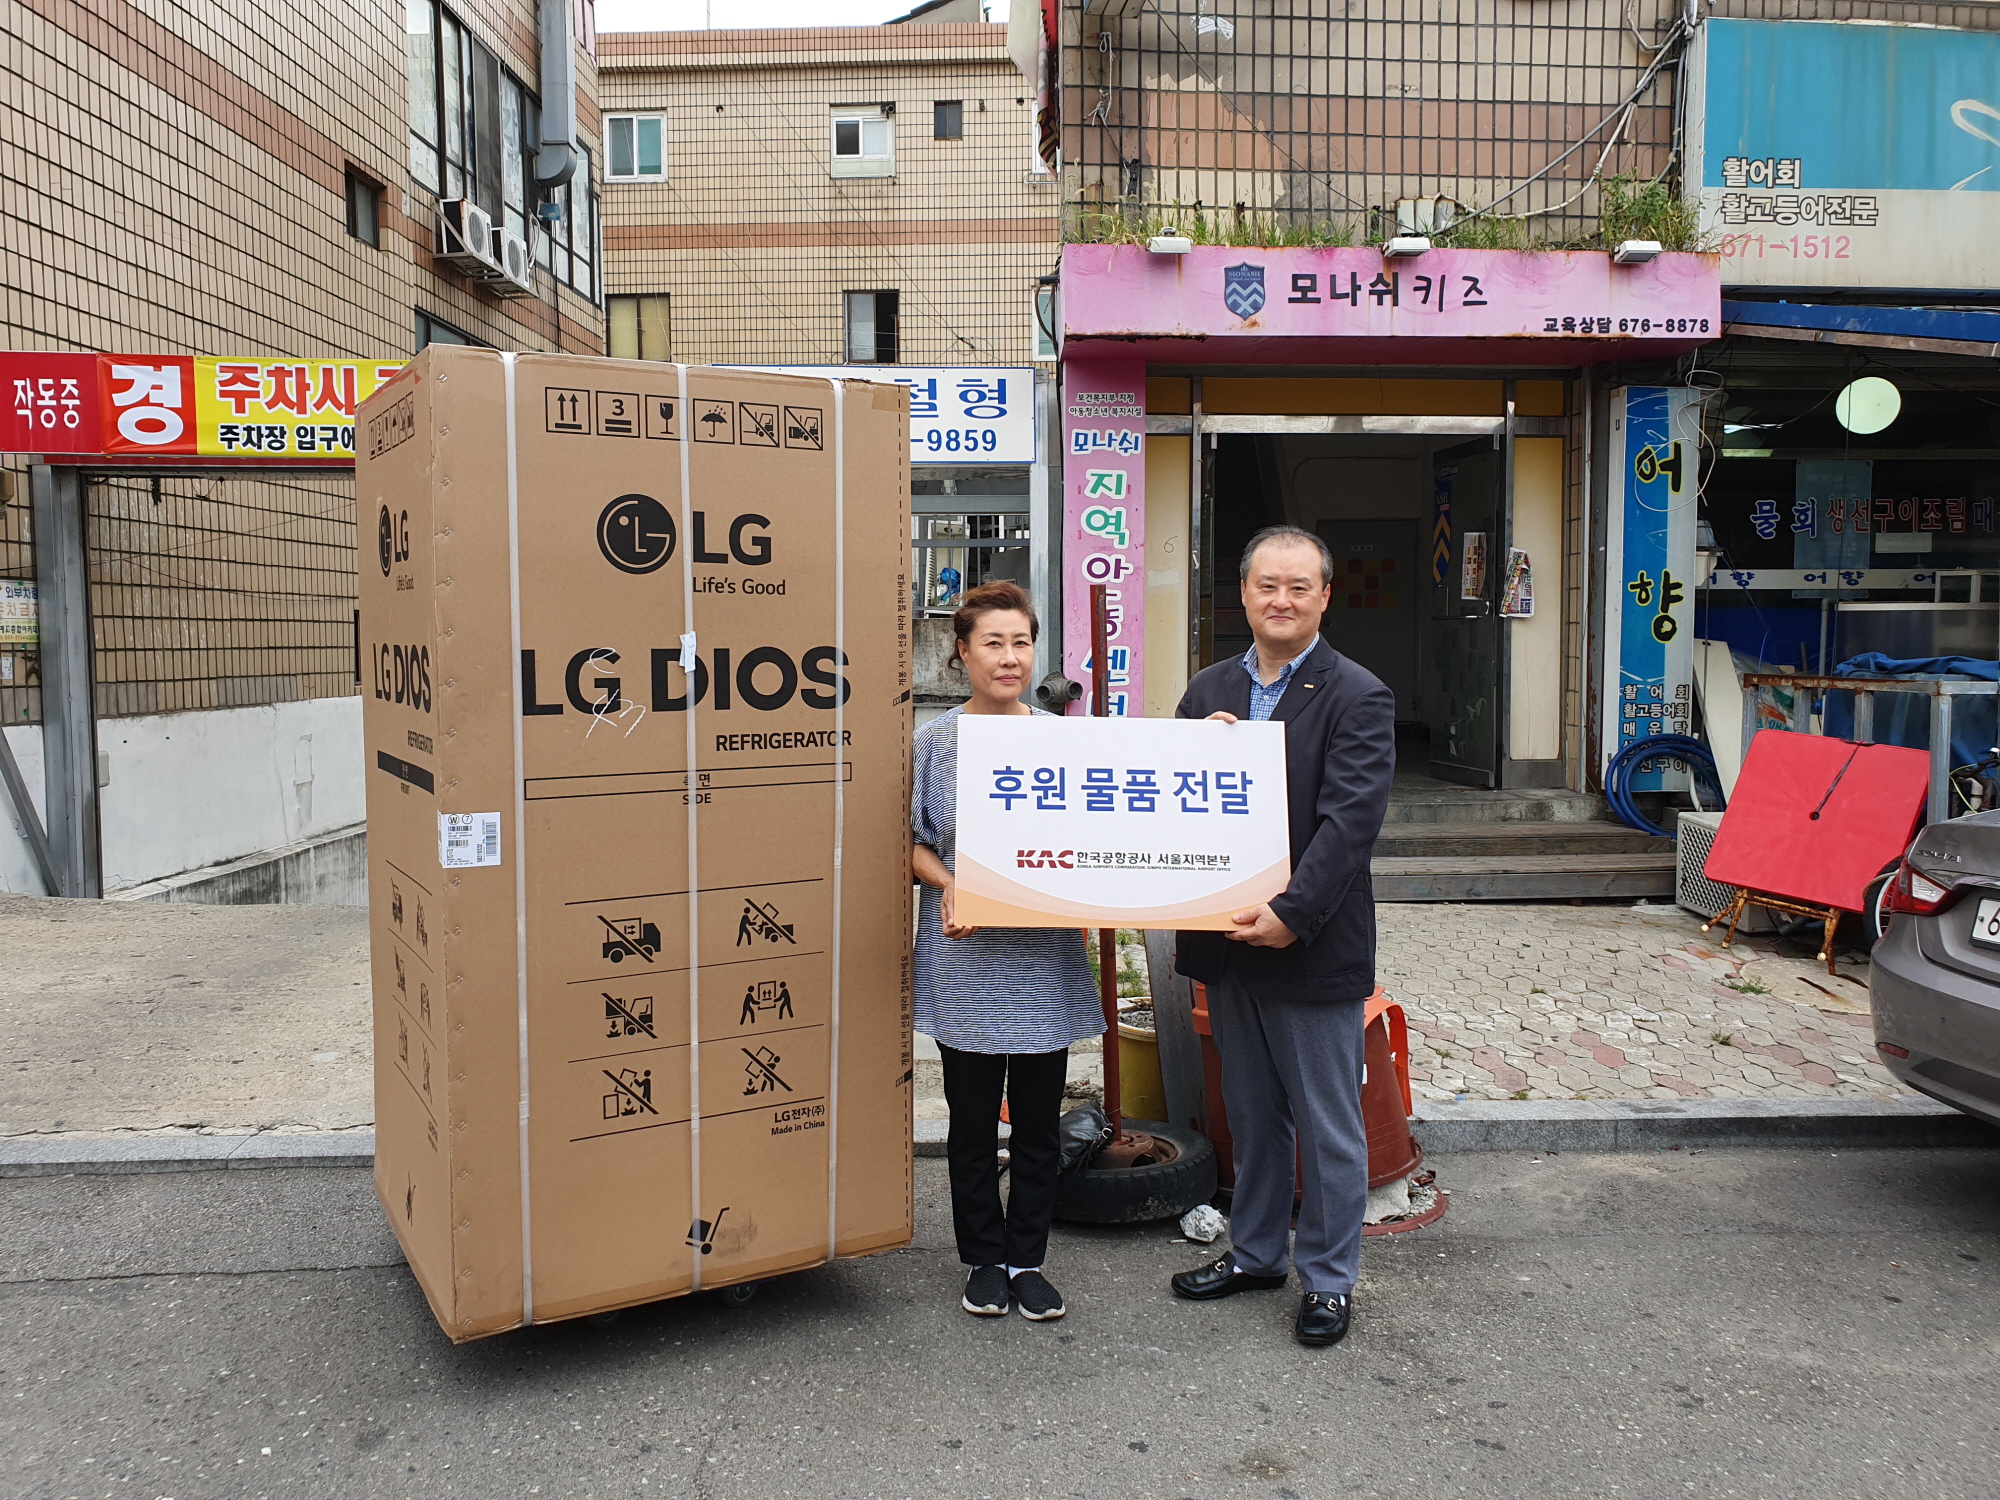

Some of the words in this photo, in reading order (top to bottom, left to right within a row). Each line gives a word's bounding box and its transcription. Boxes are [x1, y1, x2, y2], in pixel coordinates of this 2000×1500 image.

[1721, 156, 1801, 190] 활어회
[1720, 193, 1879, 227] 활고등어전문
[1720, 233, 1850, 259] 671-1512
[1543, 317, 1611, 334] 교육상담
[1618, 318, 1710, 333] 676-8878
[217, 365, 355, 416] 주차시
[1077, 393, 1116, 402] 보건복지부
[1119, 393, 1135, 402] 지정
[13, 377, 82, 429] 작동중
[110, 363, 184, 446] 경
[611, 398, 625, 416] 3
[1069, 407, 1108, 416] 아동청소년
[1111, 407, 1142, 416] 복지시설
[219, 425, 287, 450] 주차장
[1074, 431, 1140, 454] 모나쉬
[1972, 496, 2000, 534] 매
[394, 509, 410, 563] LG
[691, 509, 773, 566] LG
[692, 576, 737, 595] Life's
[741, 579, 786, 595] Good
[1803, 570, 1866, 587] 어향
[898, 615, 907, 631] 따라
[898, 632, 907, 649] 선을
[898, 650, 907, 659] 이
[898, 660, 907, 669] 시
[373, 642, 392, 702] LG
[394, 644, 433, 714] DIOS
[520, 647, 622, 717] LG
[650, 646, 852, 712] DIOS
[898, 671, 907, 687] 개봉
[1623, 702, 1689, 719] 활고등어회
[715, 730, 853, 752] REFRIGERATOR
[1621, 757, 1688, 774] 선구이
[682, 793, 712, 805] SDE
[989, 766, 1067, 811] 후원
[1081, 767, 1161, 812] 물품
[1173, 769, 1254, 815] 전달
[1016, 849, 1074, 869] KAC
[1077, 851, 1152, 864] 한국공항공사
[1157, 853, 1231, 867] 서울지역본부
[900, 995, 910, 1012] 따라
[900, 1013, 910, 1029] 선을
[900, 1031, 910, 1039] 이
[900, 1040, 910, 1049] 시
[900, 1051, 910, 1067] 개봉
[774, 1104, 825, 1124] LG전자(주)
[771, 1125, 793, 1136] Made
[794, 1123, 802, 1132] in
[803, 1120, 826, 1130] China
